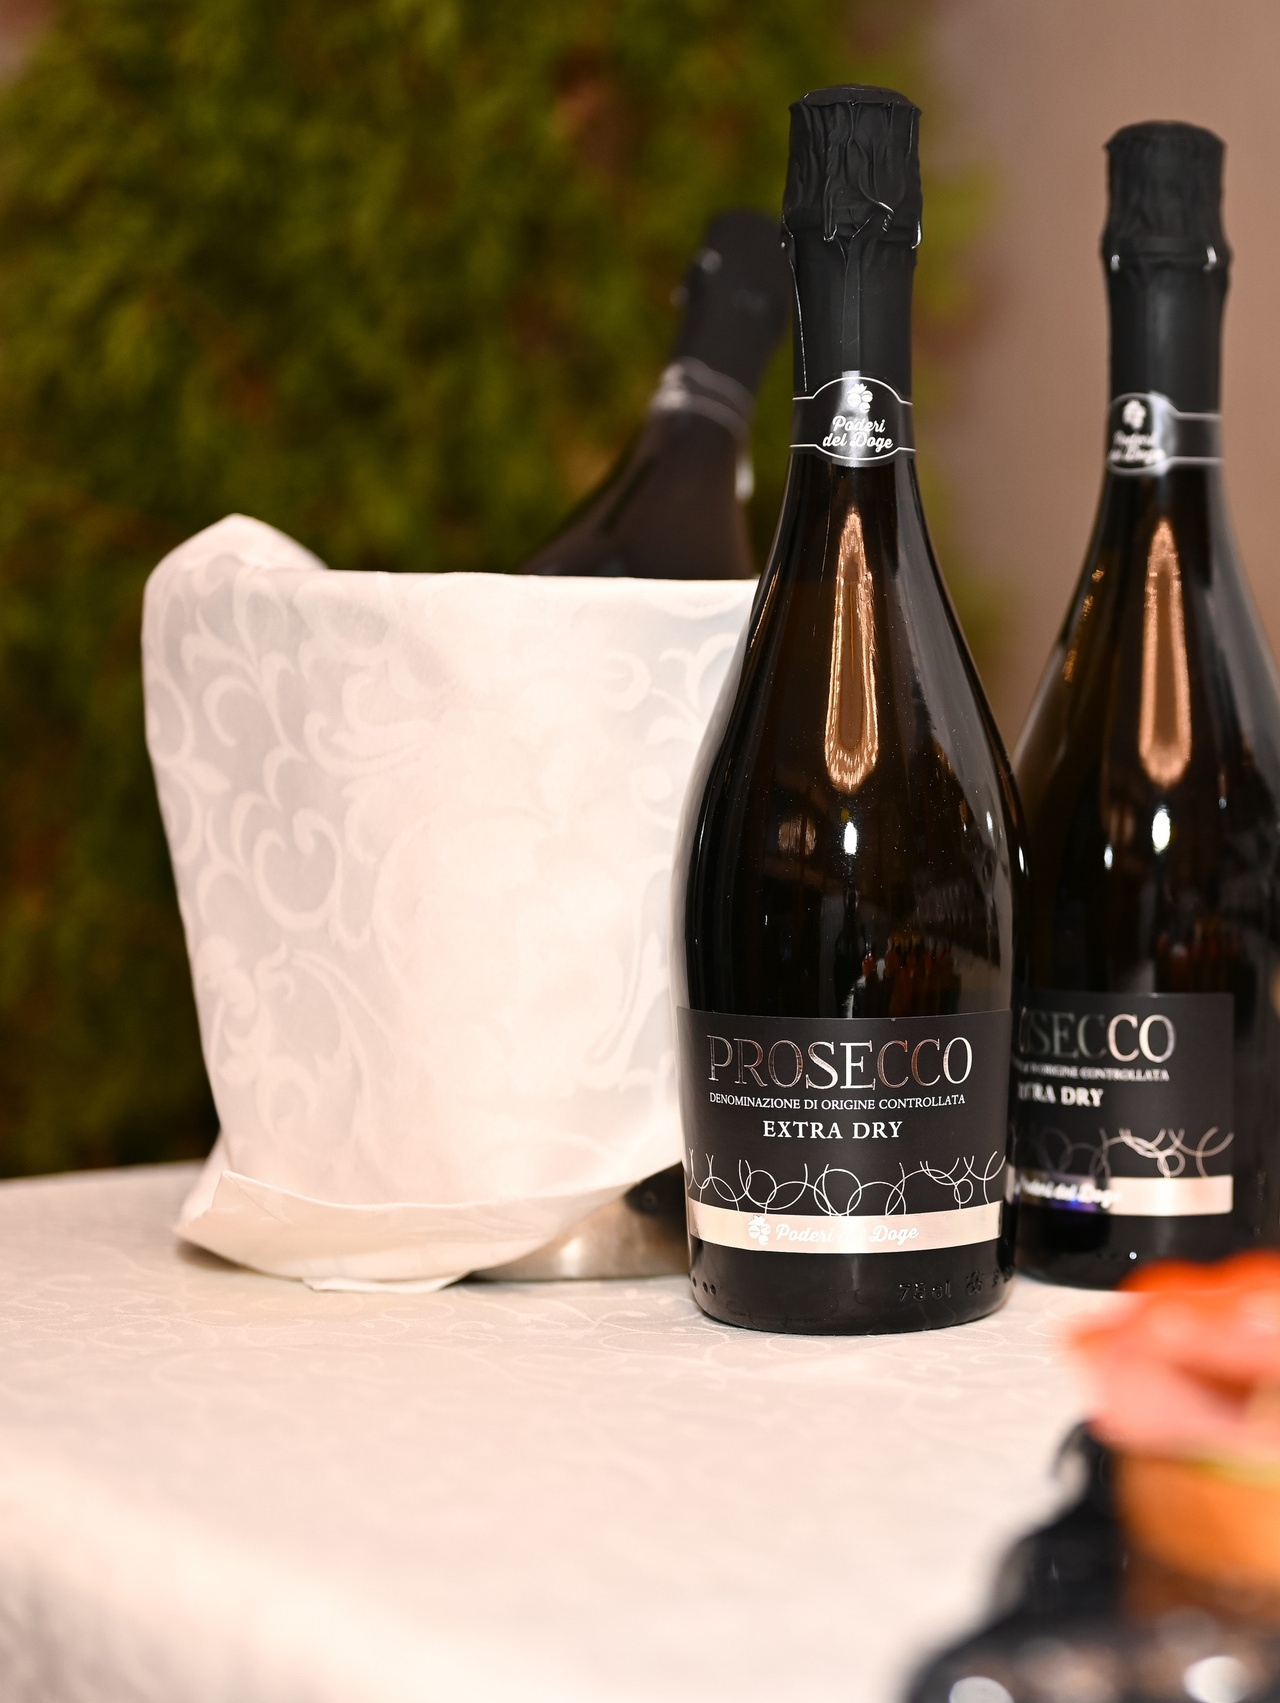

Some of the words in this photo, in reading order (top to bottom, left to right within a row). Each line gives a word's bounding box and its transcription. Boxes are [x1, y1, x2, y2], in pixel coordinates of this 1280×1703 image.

[832, 415, 885, 433] Poderi
[822, 433, 847, 447] del
[850, 431, 893, 453] Doge
[707, 1035, 973, 1090] PROSECCO
[709, 1092, 801, 1110] DENOMINAZIONE
[804, 1099, 818, 1110] DI
[821, 1099, 876, 1110] ORIGINE
[878, 1094, 966, 1110] CONTROLLATA
[1060, 1086, 1104, 1108] DRY
[762, 1120, 844, 1139] EXTRA
[852, 1121, 903, 1139] DRY
[775, 1223, 835, 1243] Poderi
[869, 1224, 920, 1246] Doge
